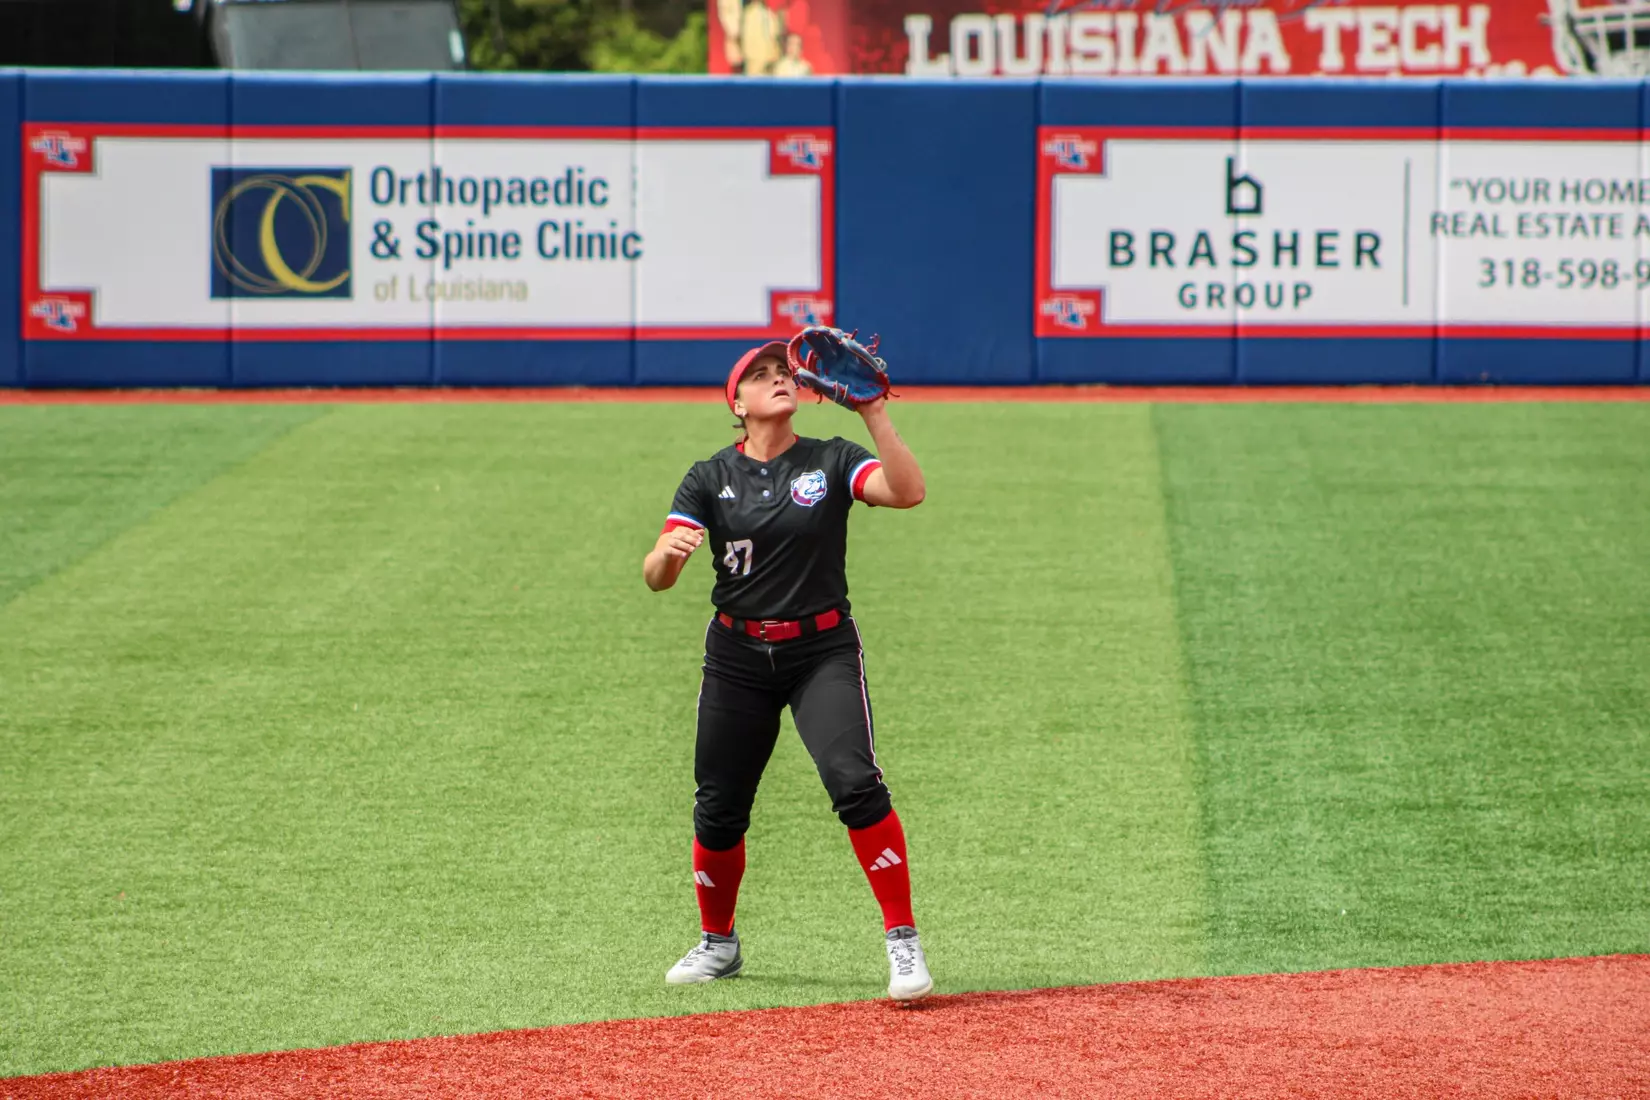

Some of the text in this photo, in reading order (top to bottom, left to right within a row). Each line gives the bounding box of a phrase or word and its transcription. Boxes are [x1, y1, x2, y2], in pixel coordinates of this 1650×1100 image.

[904, 4, 1491, 76] LOUISIANA TECH
[370, 165, 609, 218] Orthopaedic
[1430, 211, 1508, 238] REAL
[1517, 212, 1624, 238] ESTATE
[370, 219, 644, 271] & Spine Clinic
[1108, 229, 1382, 268] BRASHER
[373, 275, 529, 302] of Louisiana
[1177, 281, 1314, 310] GROUP
